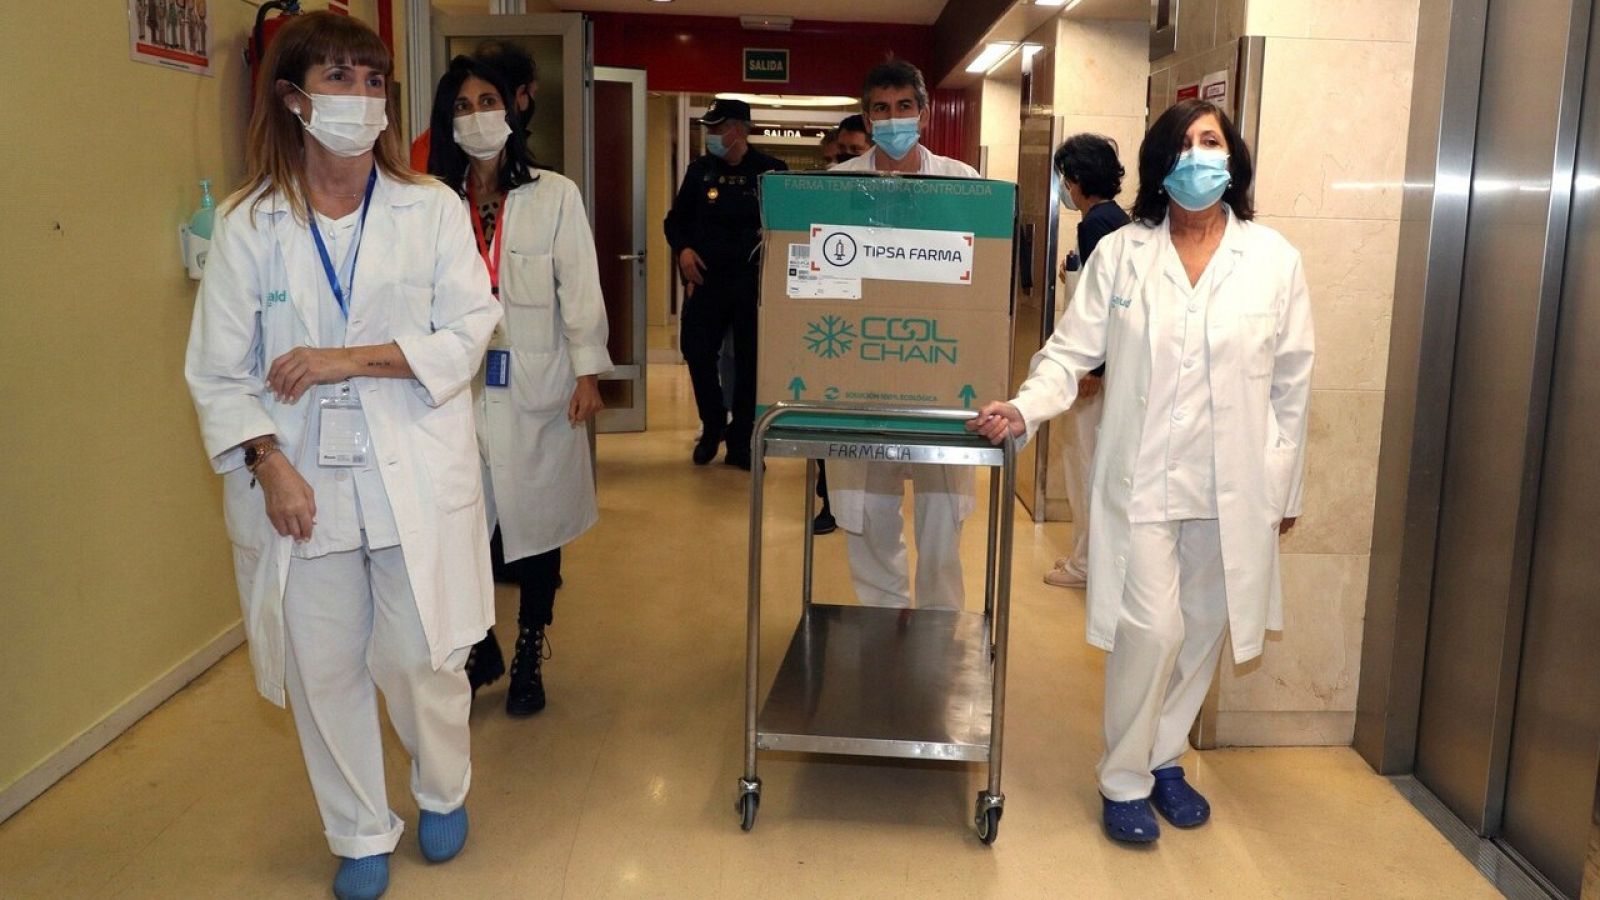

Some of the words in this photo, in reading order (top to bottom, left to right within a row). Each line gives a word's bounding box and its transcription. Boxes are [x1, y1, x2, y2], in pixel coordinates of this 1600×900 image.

[749, 60, 784, 71] SALIDA
[764, 129, 801, 138] SALIDA
[784, 179, 824, 190] FARMA
[913, 183, 992, 196] CONTROLADA
[863, 245, 906, 260] TIPSA
[909, 248, 962, 263] FARMA
[861, 316, 958, 343] COOL
[860, 343, 957, 364] CHAIN
[828, 443, 911, 461] FARMACIA
